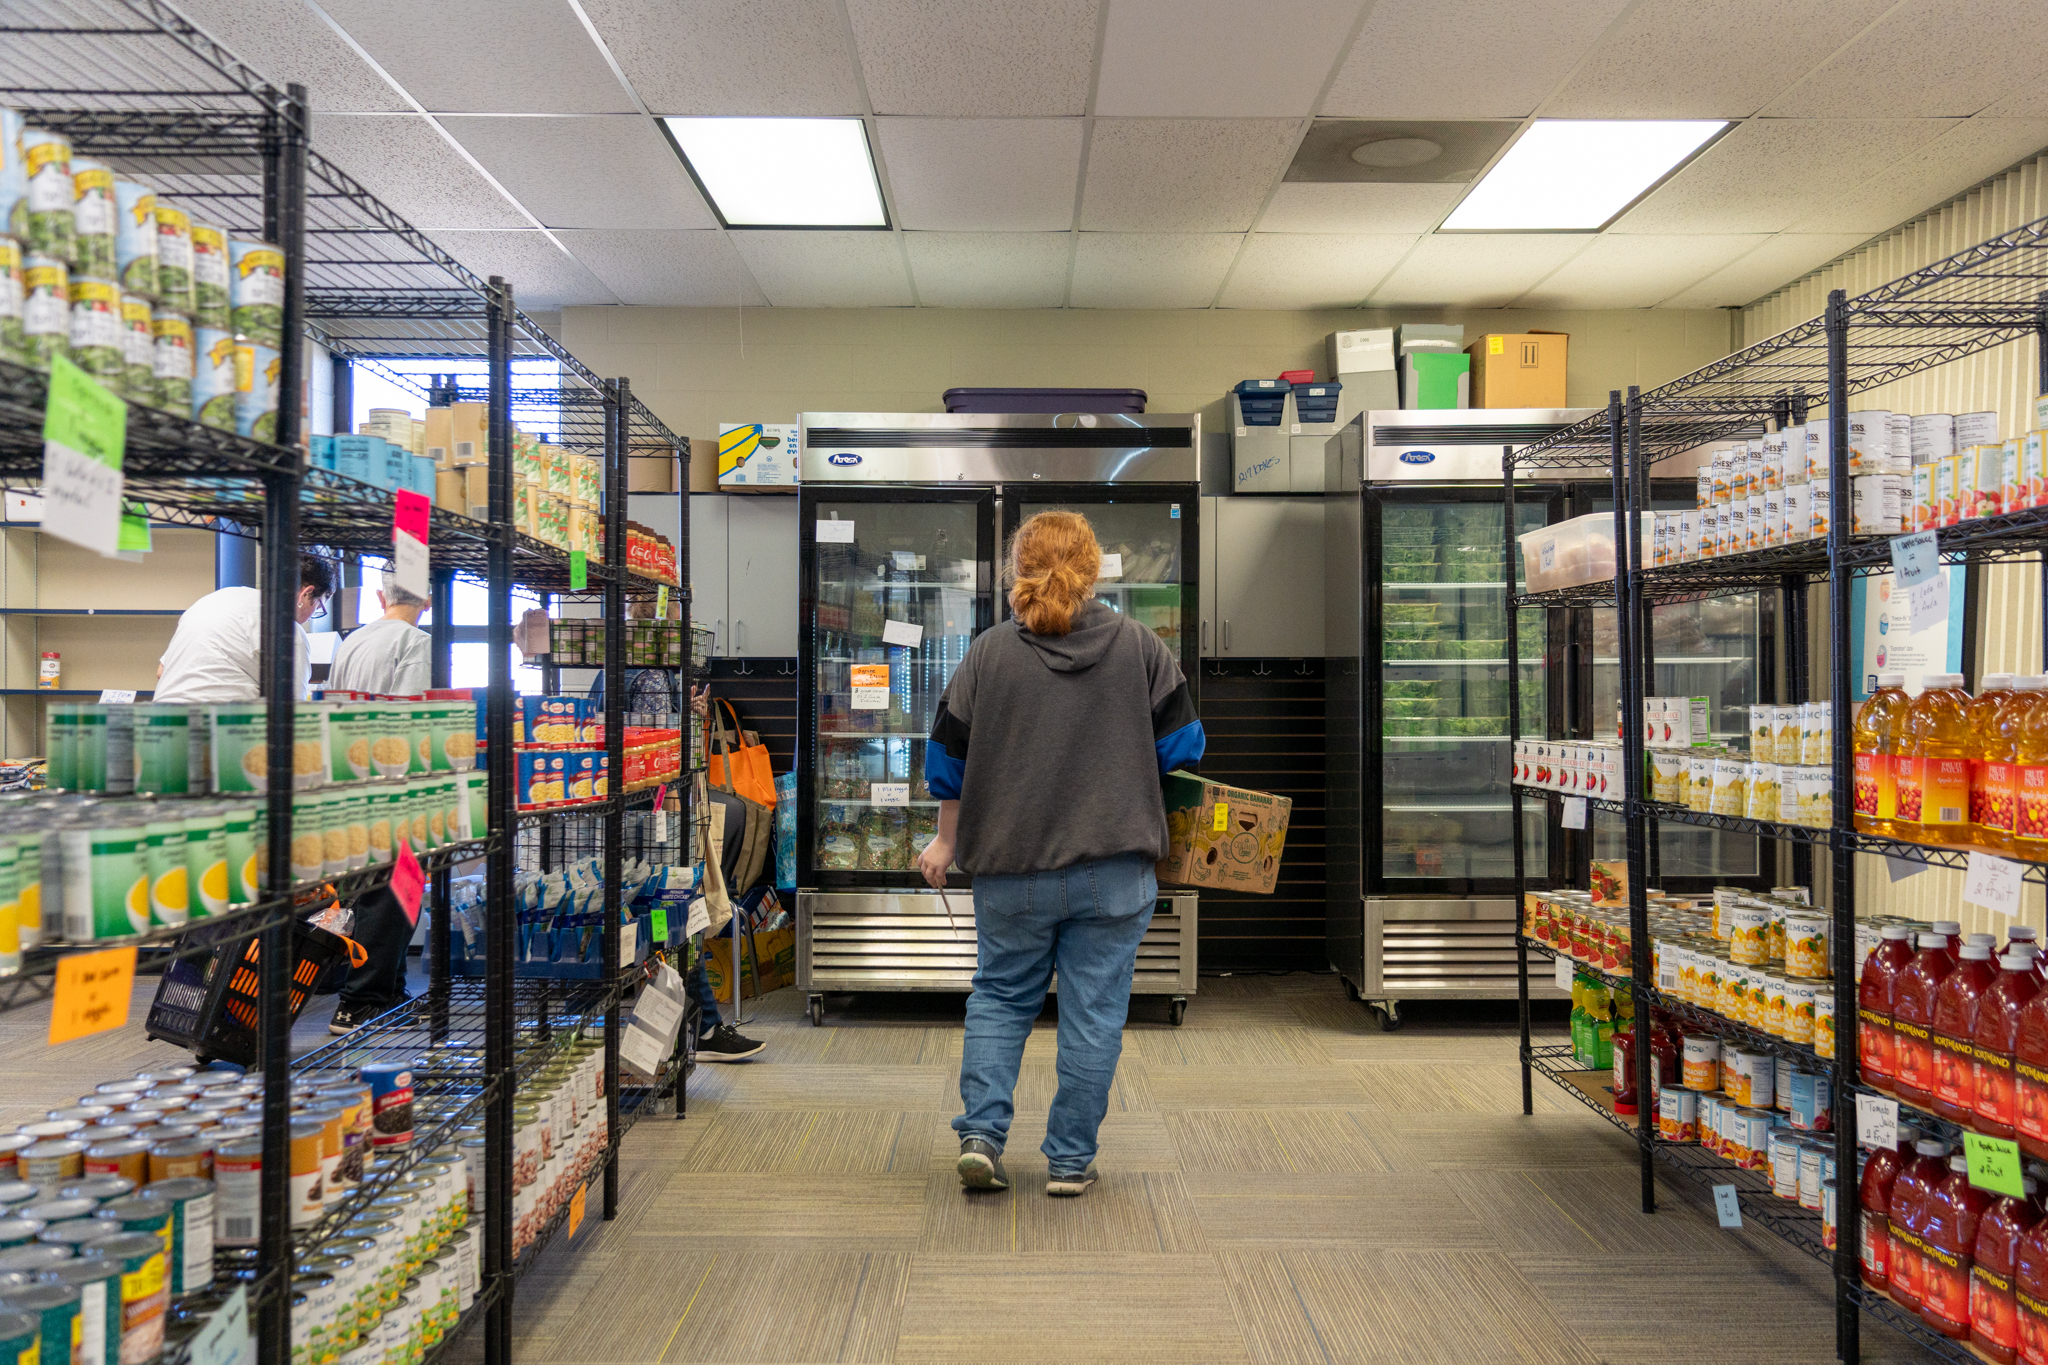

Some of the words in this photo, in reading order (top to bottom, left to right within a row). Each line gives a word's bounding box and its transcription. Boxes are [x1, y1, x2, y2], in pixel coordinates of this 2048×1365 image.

[832, 454, 859, 464] Atosa
[1404, 452, 1431, 462] Atosa
[1810, 490, 1830, 499] CHESS
[2024, 769, 2045, 779] FRUIT
[2023, 777, 2045, 788] PATCH
[1226, 789, 1250, 801] ORGANIC
[1250, 794, 1273, 805] BANANAS
[1985, 858, 2010, 875] Juice
[1985, 880, 2014, 902] fruit
[1787, 924, 1817, 933] EMCO
[1786, 987, 1815, 998] EMCO
[1894, 1021, 1929, 1039] NORTHLAND
[1933, 1035, 1973, 1055] NORTHLAND
[1973, 1048, 2010, 1069] NORTHLAND
[1865, 1100, 1890, 1115] Tomato
[1922, 1244, 1958, 1269] NORTHLAND
[1973, 1265, 2008, 1291] NORTHLAND
